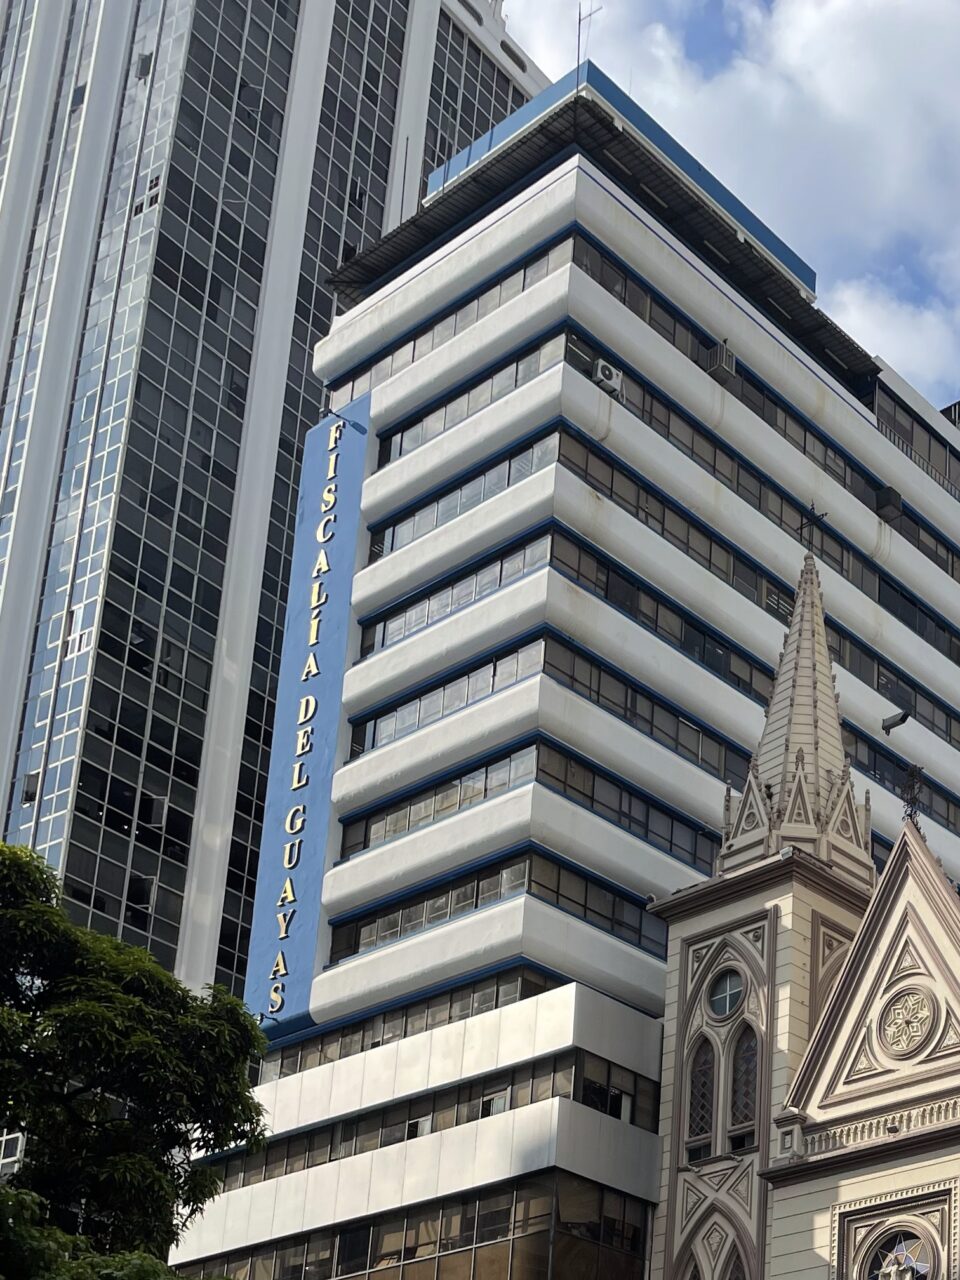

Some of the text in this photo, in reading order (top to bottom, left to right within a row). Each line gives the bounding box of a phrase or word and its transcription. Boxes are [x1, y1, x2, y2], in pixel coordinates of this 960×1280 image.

[267, 420, 346, 1014] FISCALÍA DEL GUAYAS
